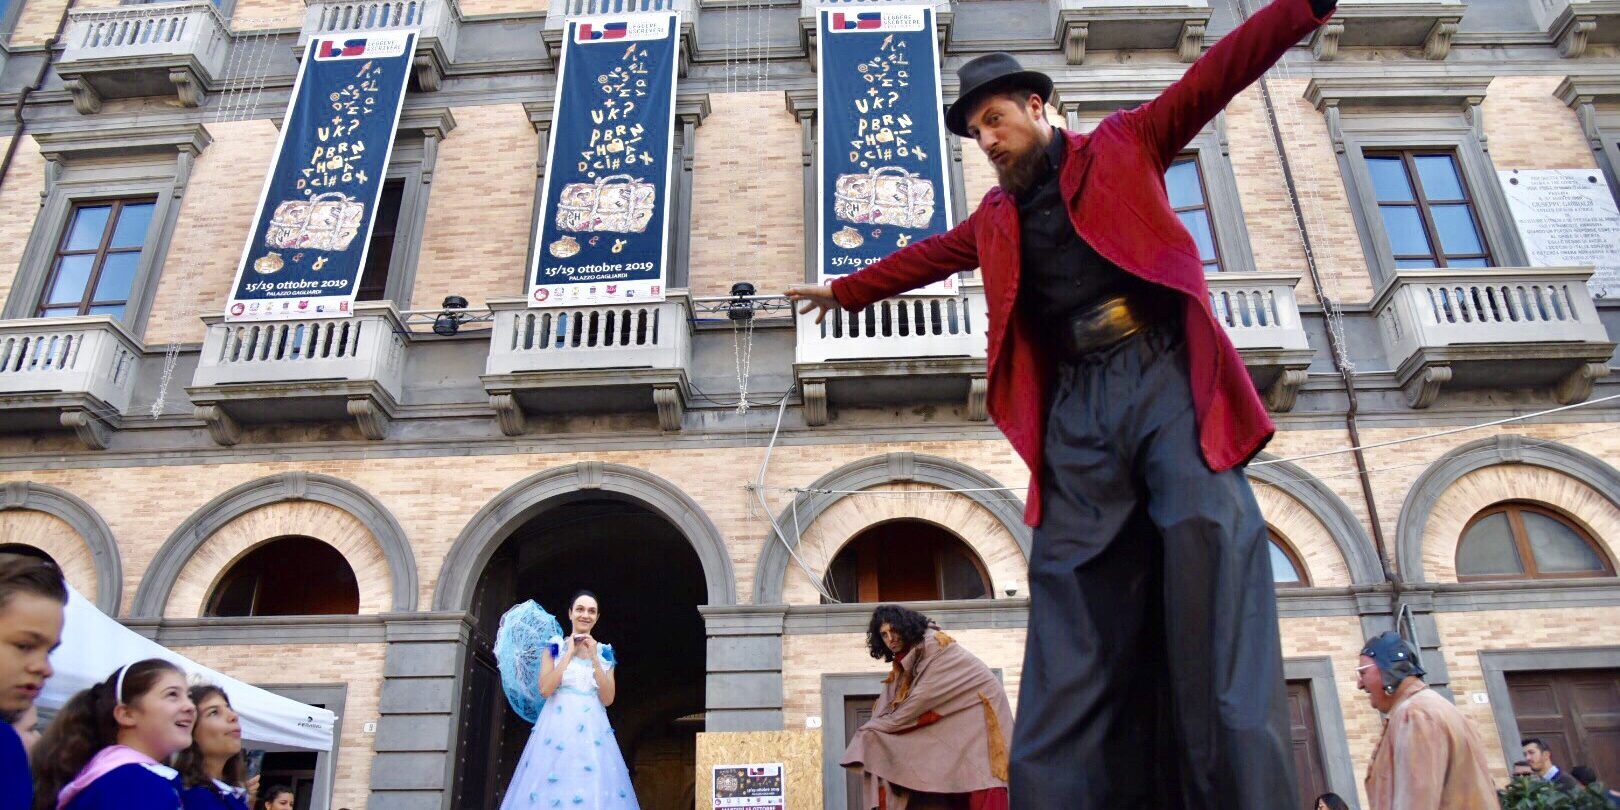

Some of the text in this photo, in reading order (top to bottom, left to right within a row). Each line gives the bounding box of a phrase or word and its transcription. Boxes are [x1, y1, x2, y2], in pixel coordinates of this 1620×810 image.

[831, 256, 861, 267] 15/19
[545, 262, 653, 277] 15/19 ottobre 2019
[245, 279, 348, 292] 15/19 ottobre 2019
